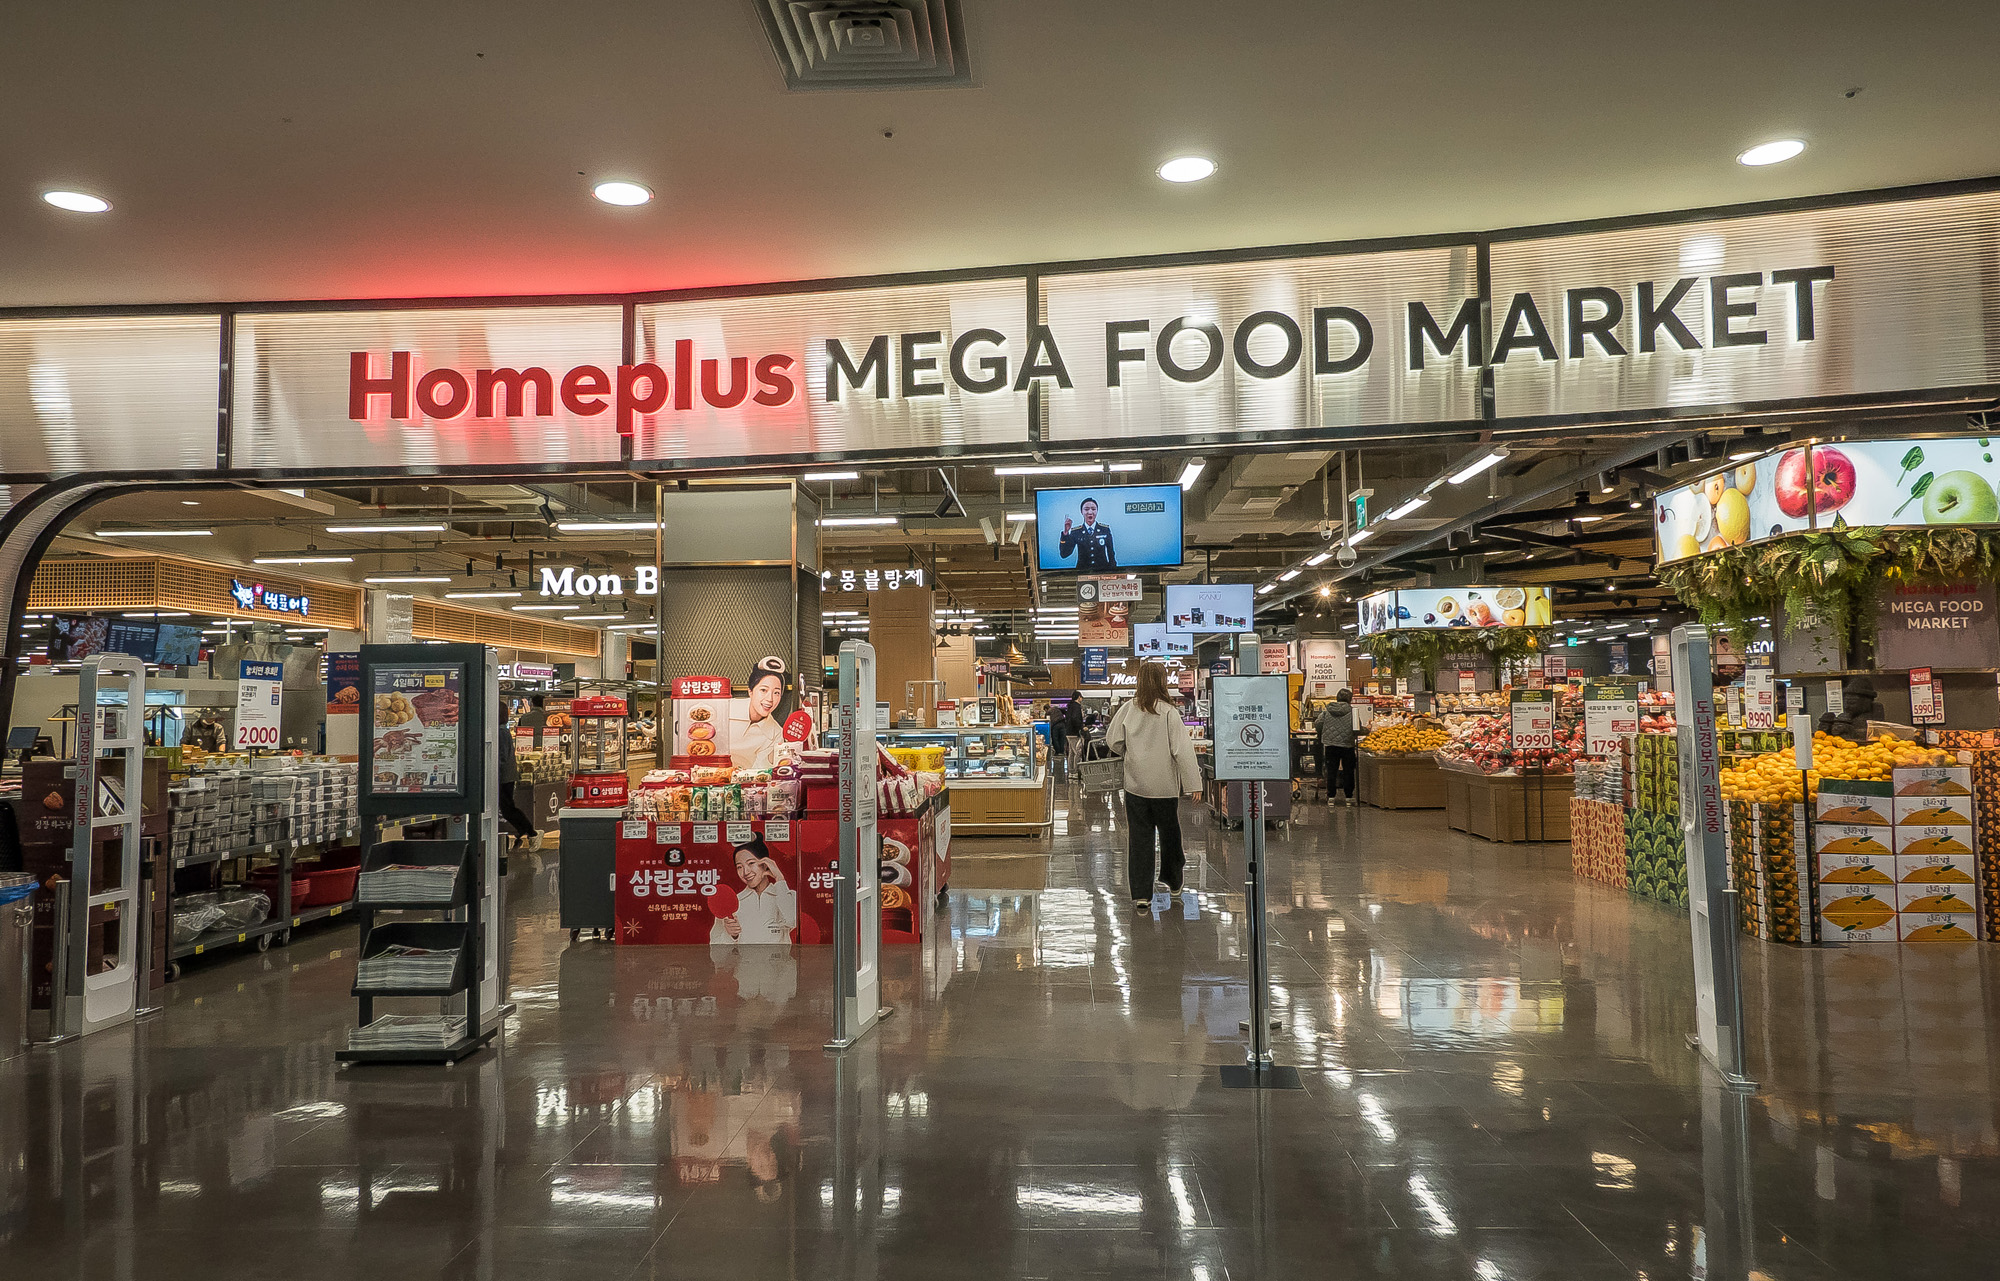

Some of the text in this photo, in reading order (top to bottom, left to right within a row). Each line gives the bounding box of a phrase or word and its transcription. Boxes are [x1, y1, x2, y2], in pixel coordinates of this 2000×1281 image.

[349, 265, 1836, 434] Homeplus MEGA FOOD MARKET
[1127, 503, 1163, 512] #의심하고
[540, 567, 623, 596] Mon
[1891, 600, 1984, 613] MEGA FOOD
[1907, 617, 1969, 629] MARKET
[393, 678, 423, 687] 4일특가
[1111, 673, 1137, 685] Mea
[680, 681, 722, 695] 삼립호빵
[238, 726, 278, 745] 2,000
[1515, 734, 1550, 747] 9,990
[77, 712, 92, 826] 도난경보기 작동중
[841, 704, 853, 823] 도난경보기 작동중
[1696, 700, 1720, 833] 도난경보기 작동중
[601, 787, 623, 796] 삼립호빵
[35, 820, 50, 830] 김장
[629, 868, 721, 897] 삼립호빵
[662, 913, 689, 921] 삼립호빵
